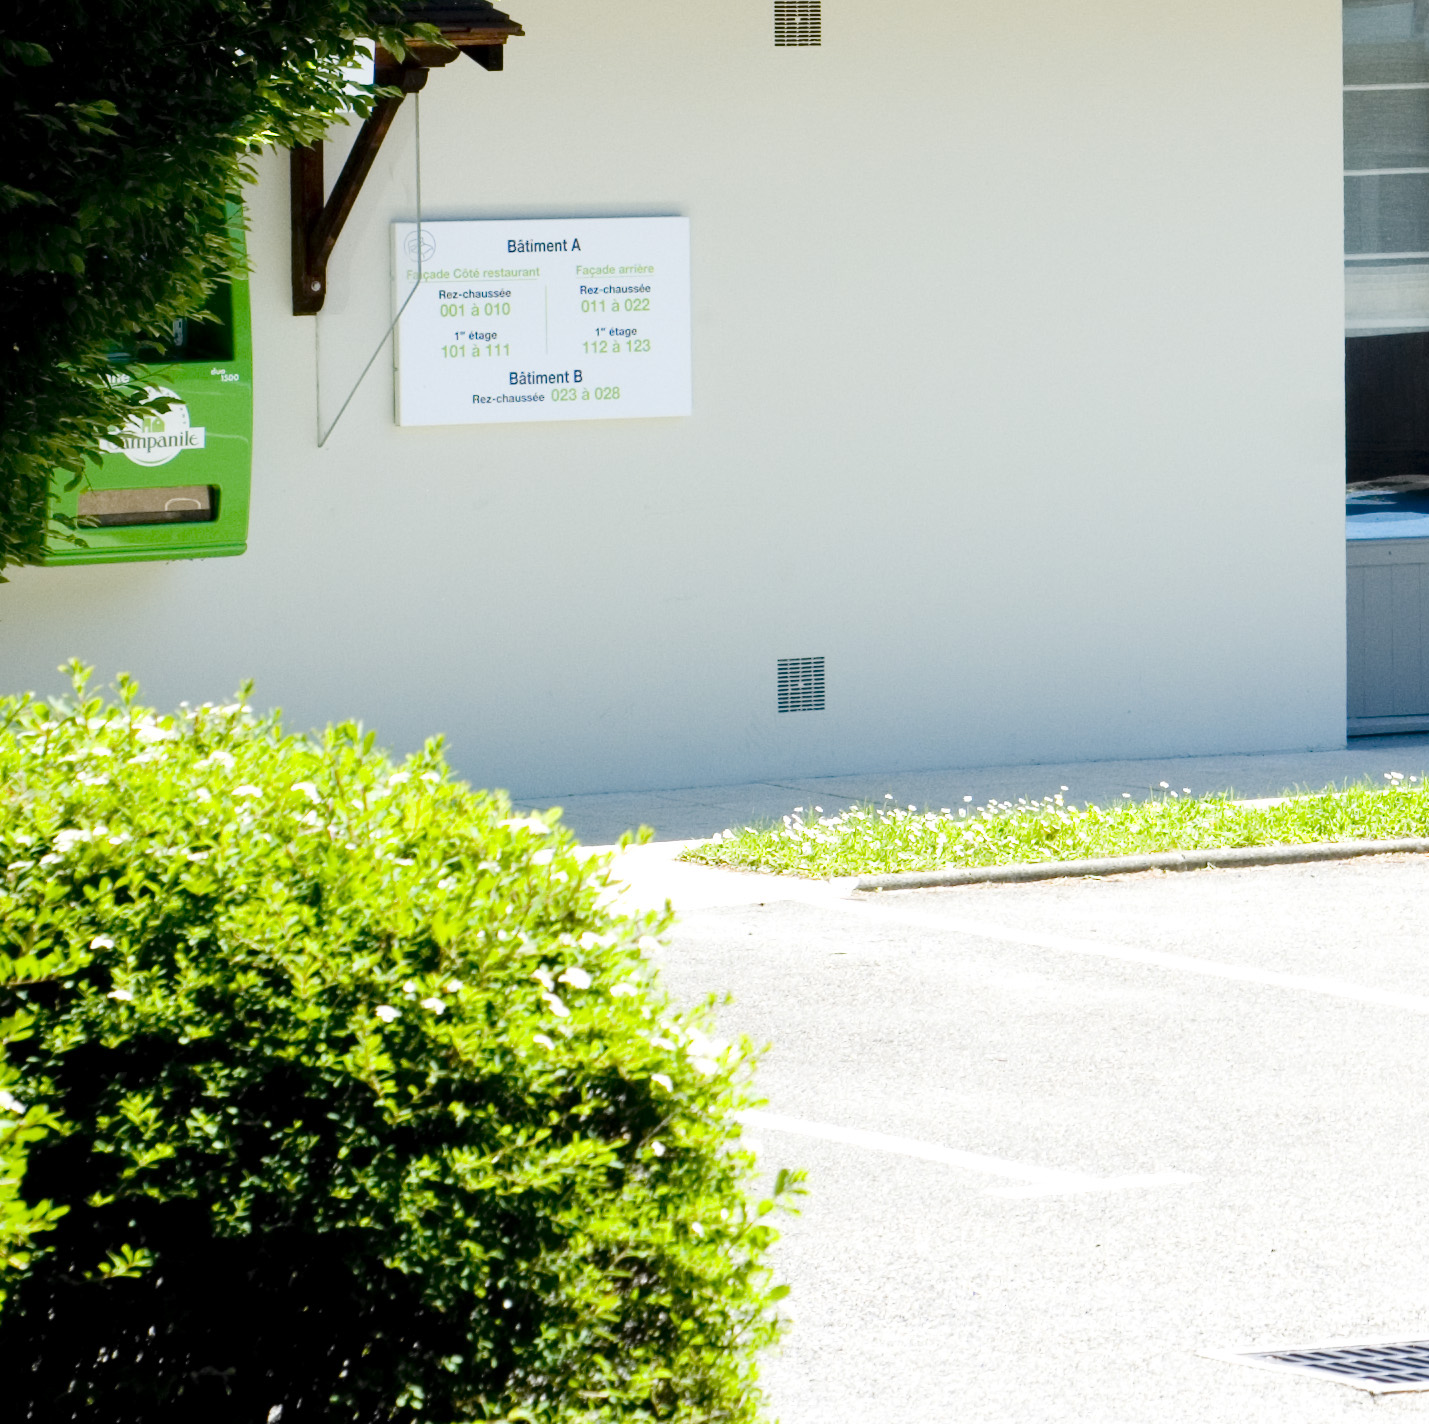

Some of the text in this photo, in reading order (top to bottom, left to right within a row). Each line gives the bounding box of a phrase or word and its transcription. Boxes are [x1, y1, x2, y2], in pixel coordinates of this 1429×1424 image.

[507, 237, 582, 253] Bâtiment A
[453, 267, 480, 279] Côté
[483, 267, 541, 278] restaurant
[576, 263, 655, 278] Façade arrière
[438, 288, 512, 299] Rez-chaussée
[579, 283, 651, 295] Rez-chaussée
[440, 302, 511, 317] 001 à 010
[581, 298, 650, 313] 011 à 022
[468, 331, 498, 341] étage
[609, 327, 637, 338] étage
[441, 344, 510, 358] 101 à 111
[582, 339, 651, 354] 112 à 123
[509, 369, 583, 385] Bâtiment B
[472, 387, 620, 404] Rez-chaussée 023 à 028
